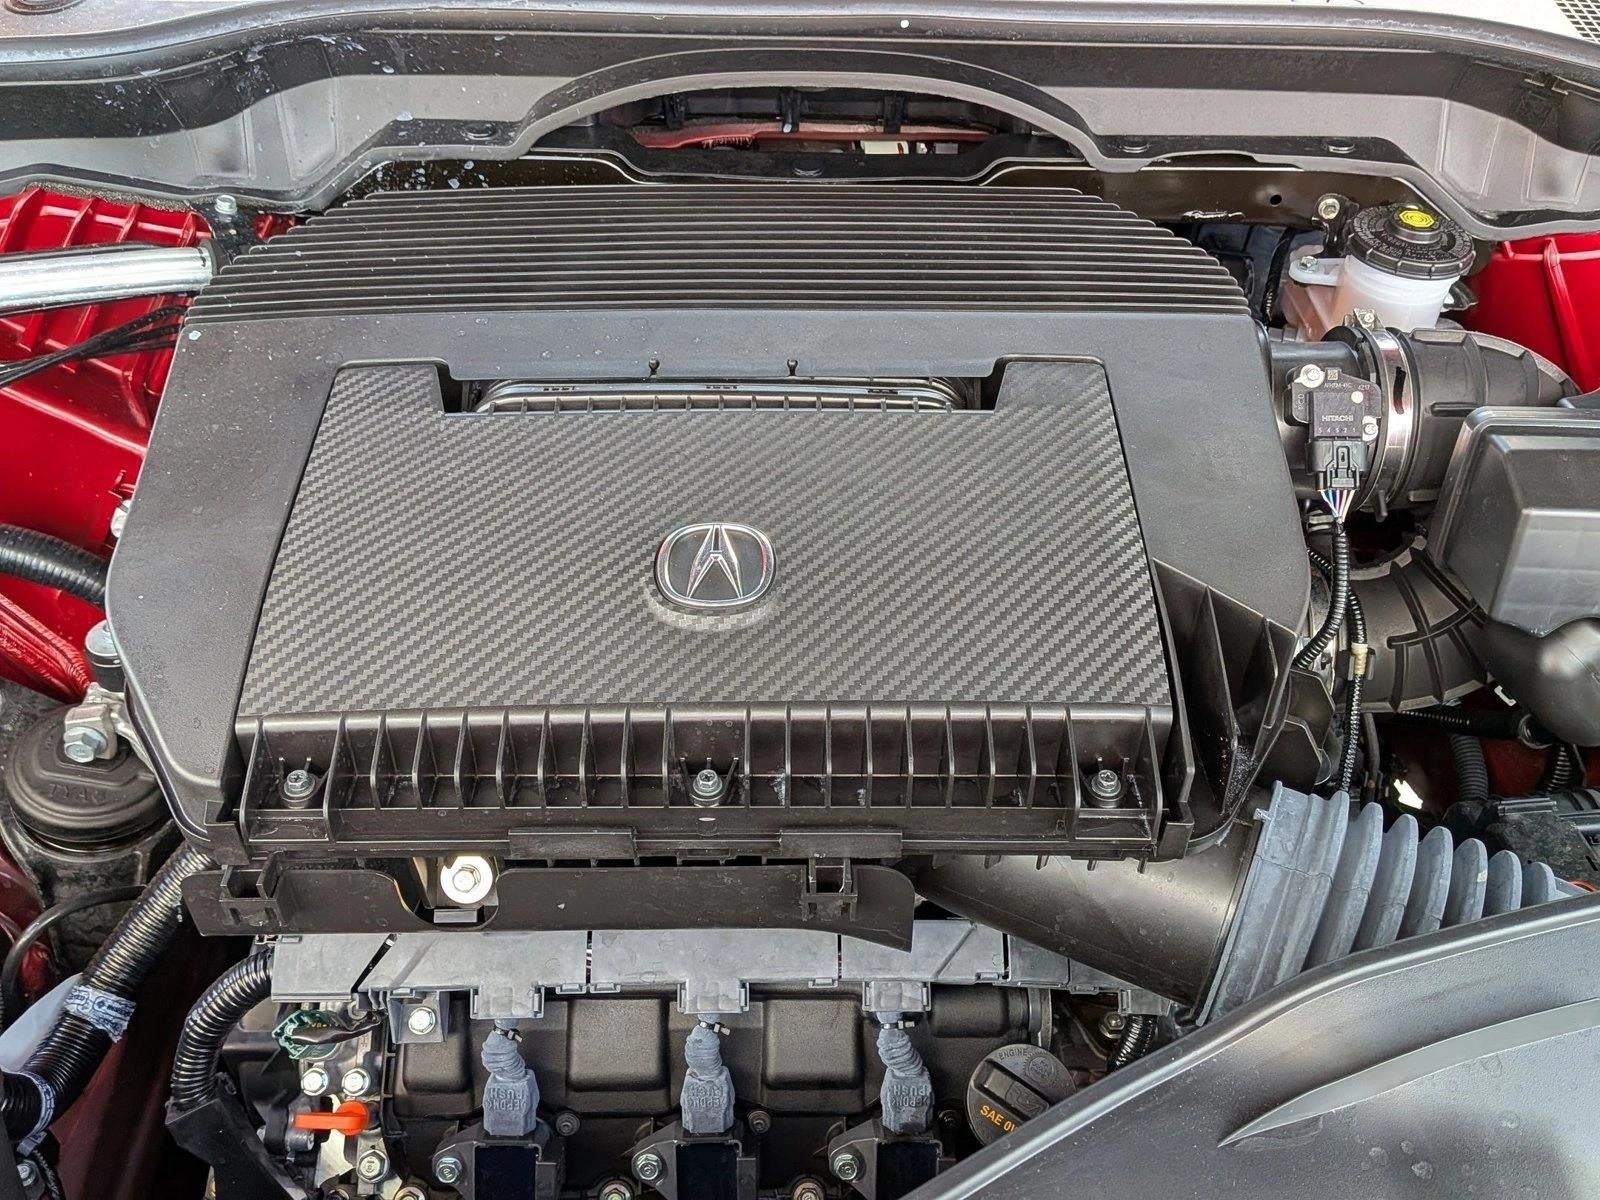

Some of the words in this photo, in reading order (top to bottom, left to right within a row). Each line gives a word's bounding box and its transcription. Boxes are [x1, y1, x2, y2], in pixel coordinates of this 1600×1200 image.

[998, 1047, 1028, 1061] ENGINE
[490, 1087, 523, 1100] PUSH
[892, 1084, 927, 1096] PUSH
[980, 1105, 1004, 1126] SAE
